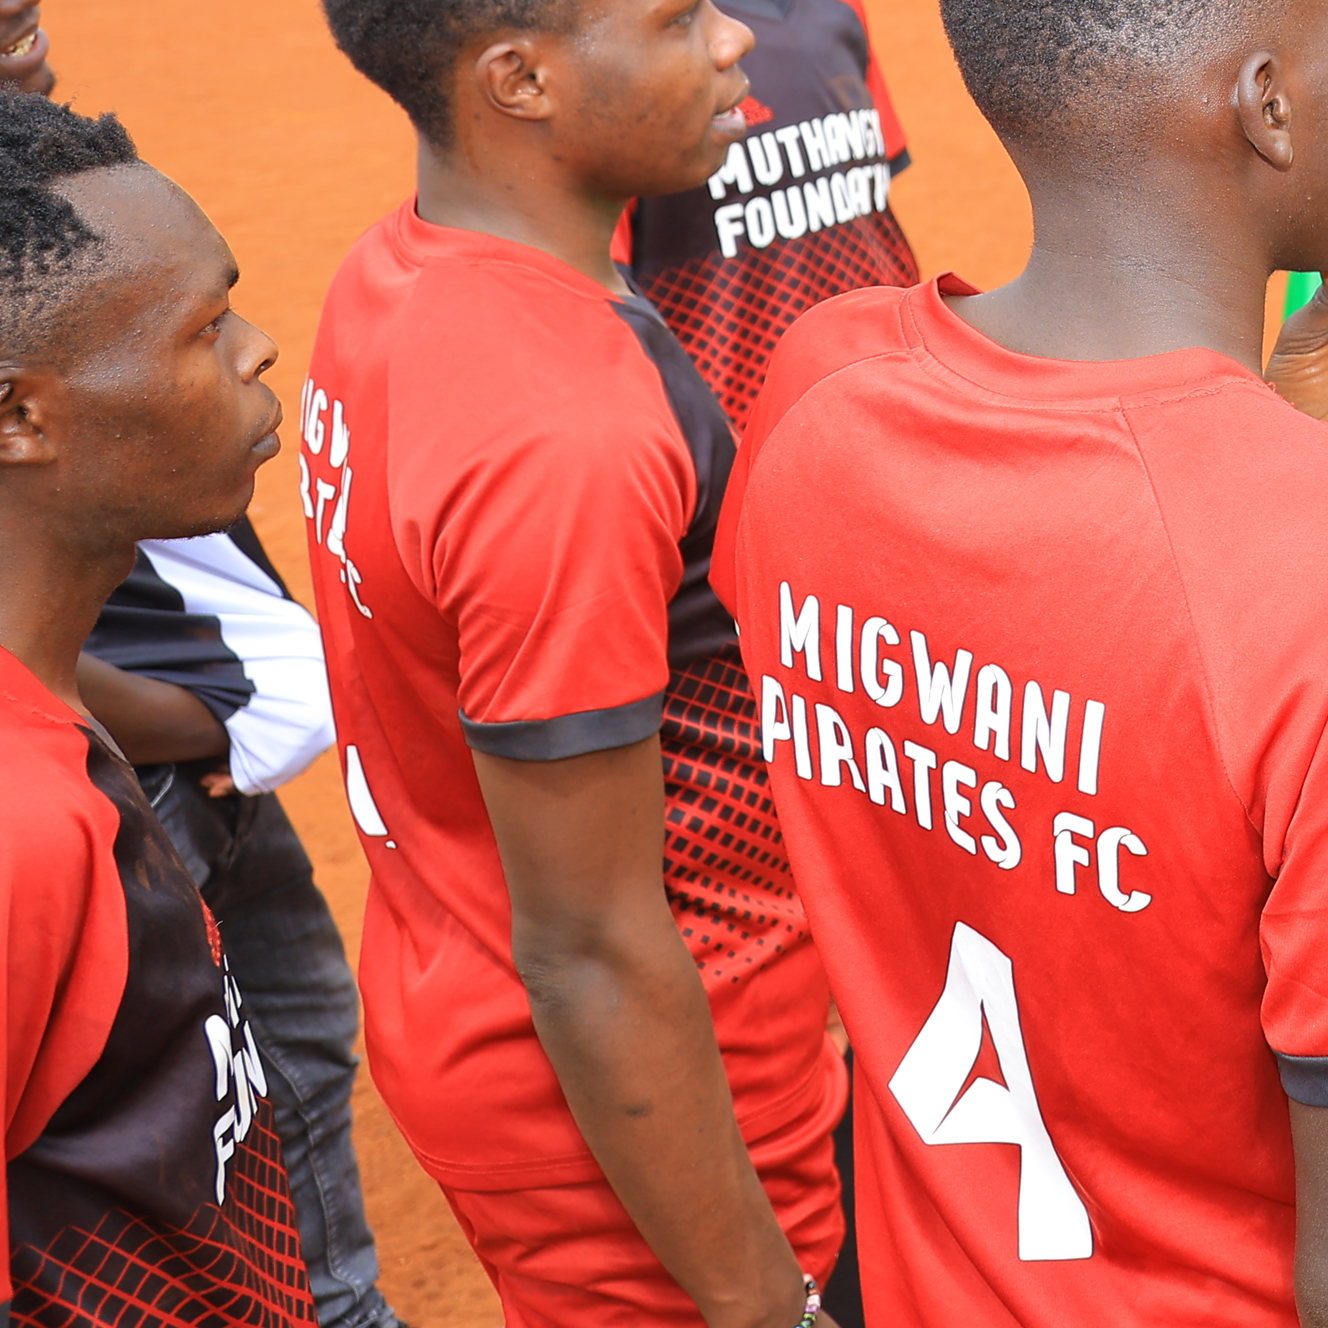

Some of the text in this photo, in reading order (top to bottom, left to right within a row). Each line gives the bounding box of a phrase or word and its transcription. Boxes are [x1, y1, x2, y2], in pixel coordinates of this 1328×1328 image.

[761, 674, 1153, 913] PIRATES FC
[779, 580, 1106, 796] MIGWANI
[887, 920, 1094, 1262] 4
